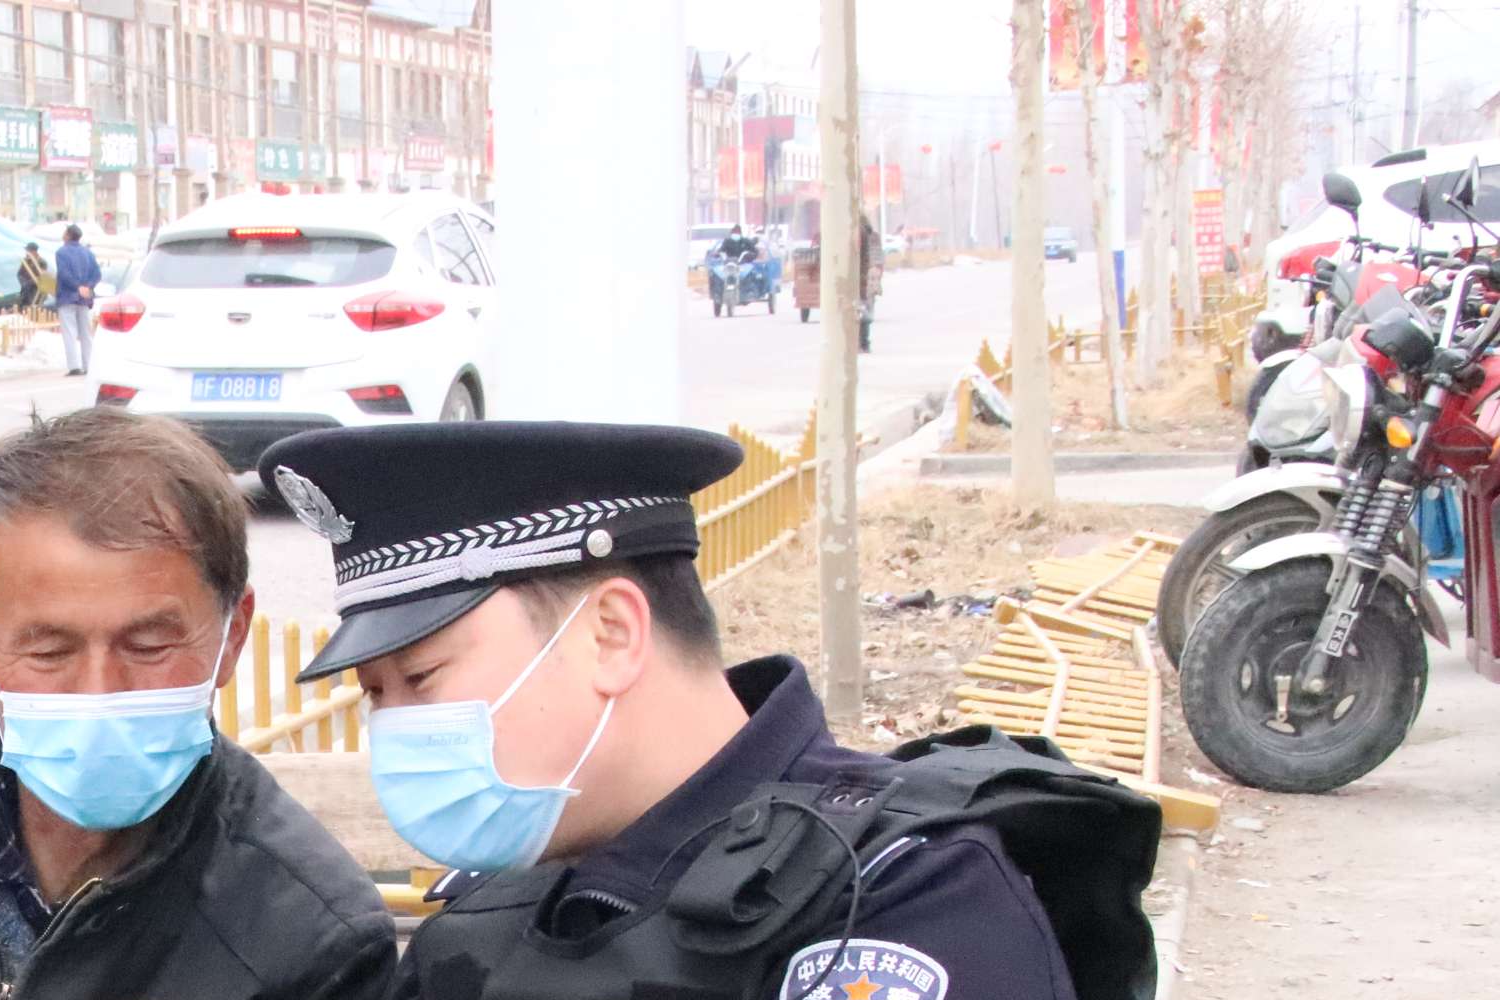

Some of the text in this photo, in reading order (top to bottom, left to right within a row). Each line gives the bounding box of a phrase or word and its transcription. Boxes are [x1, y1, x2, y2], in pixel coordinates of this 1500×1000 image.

[220, 376, 280, 398] 08B18
[797, 950, 936, 993] 中华人民共和国
